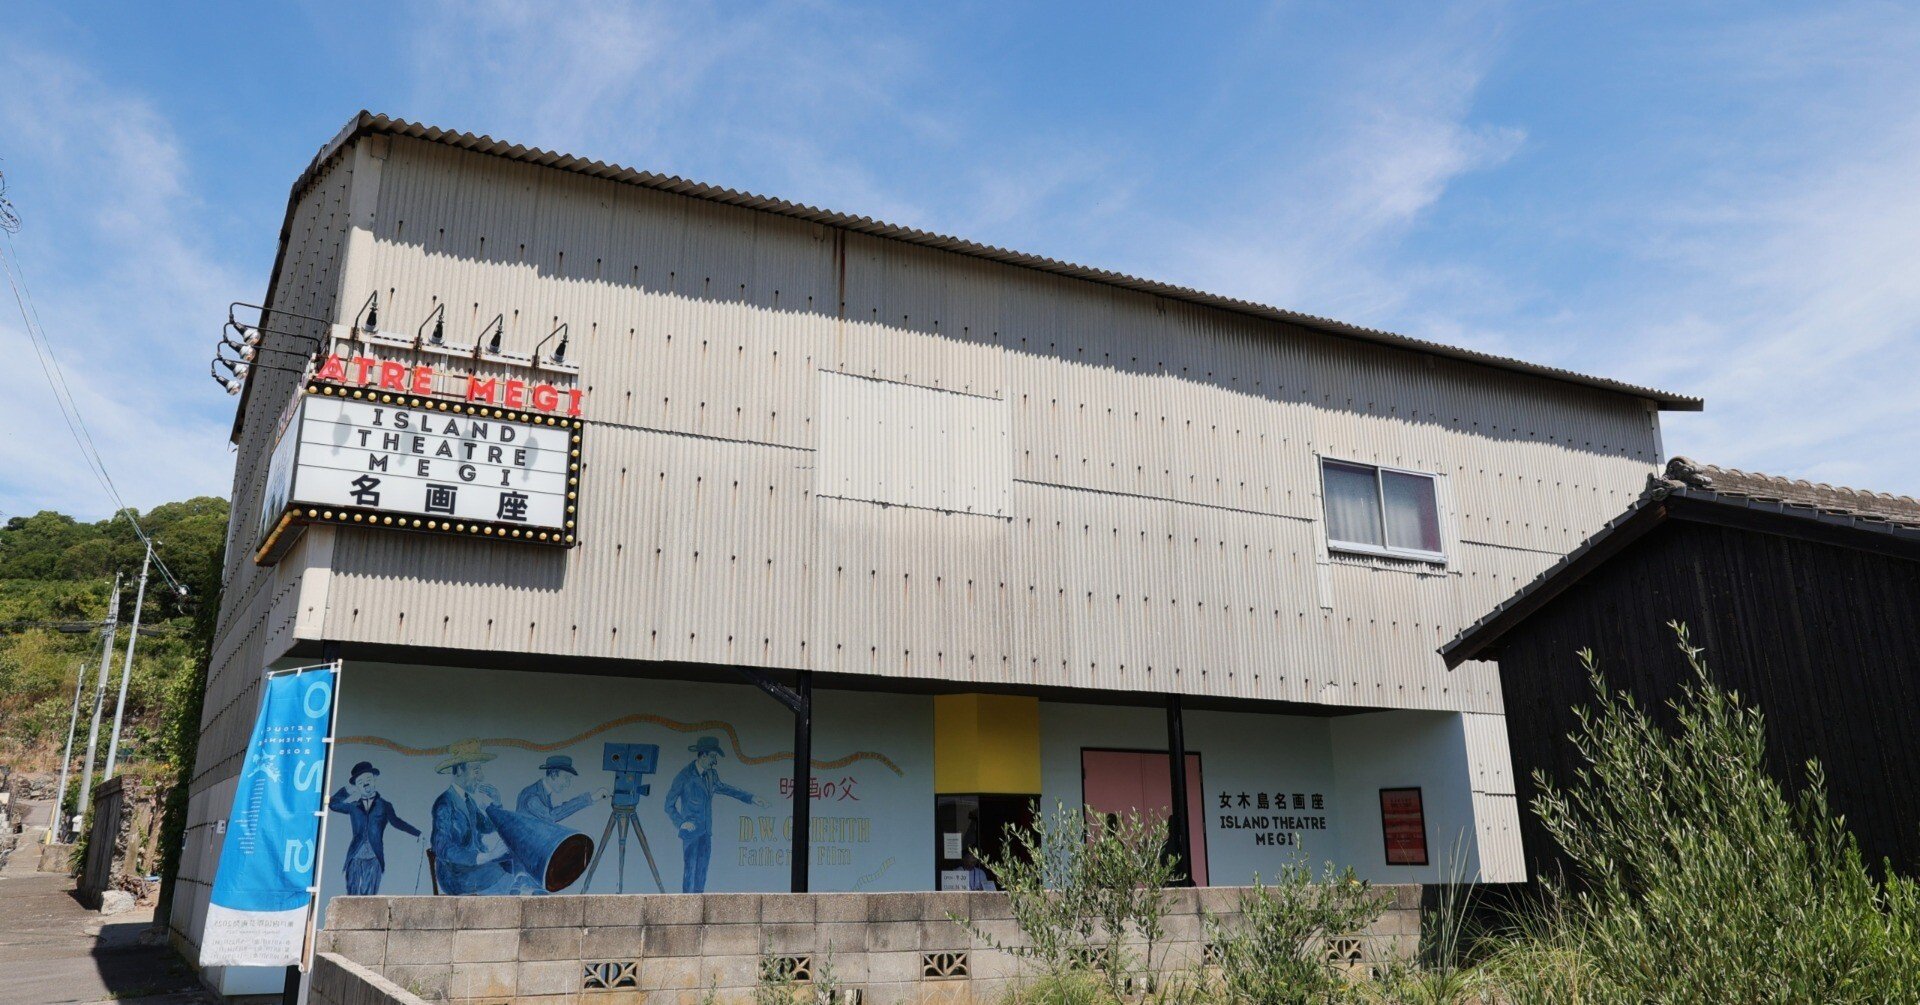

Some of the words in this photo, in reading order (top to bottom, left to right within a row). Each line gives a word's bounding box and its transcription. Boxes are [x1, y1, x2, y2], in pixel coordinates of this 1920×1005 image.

[317, 353, 433, 395] ATRE
[466, 373, 584, 417] MEGI
[372, 408, 516, 443] ISLAND
[357, 429, 527, 467] THEATRE
[368, 453, 511, 487] MEGI
[349, 474, 529, 522] 名画座
[1219, 791, 1324, 810] 女木島名画座
[738, 815, 778, 843] D.W.
[783, 815, 872, 843] GIFFITH
[1220, 815, 1269, 830] ISLAND
[1272, 816, 1326, 830] THEATRE
[1255, 832, 1294, 846] MEGI
